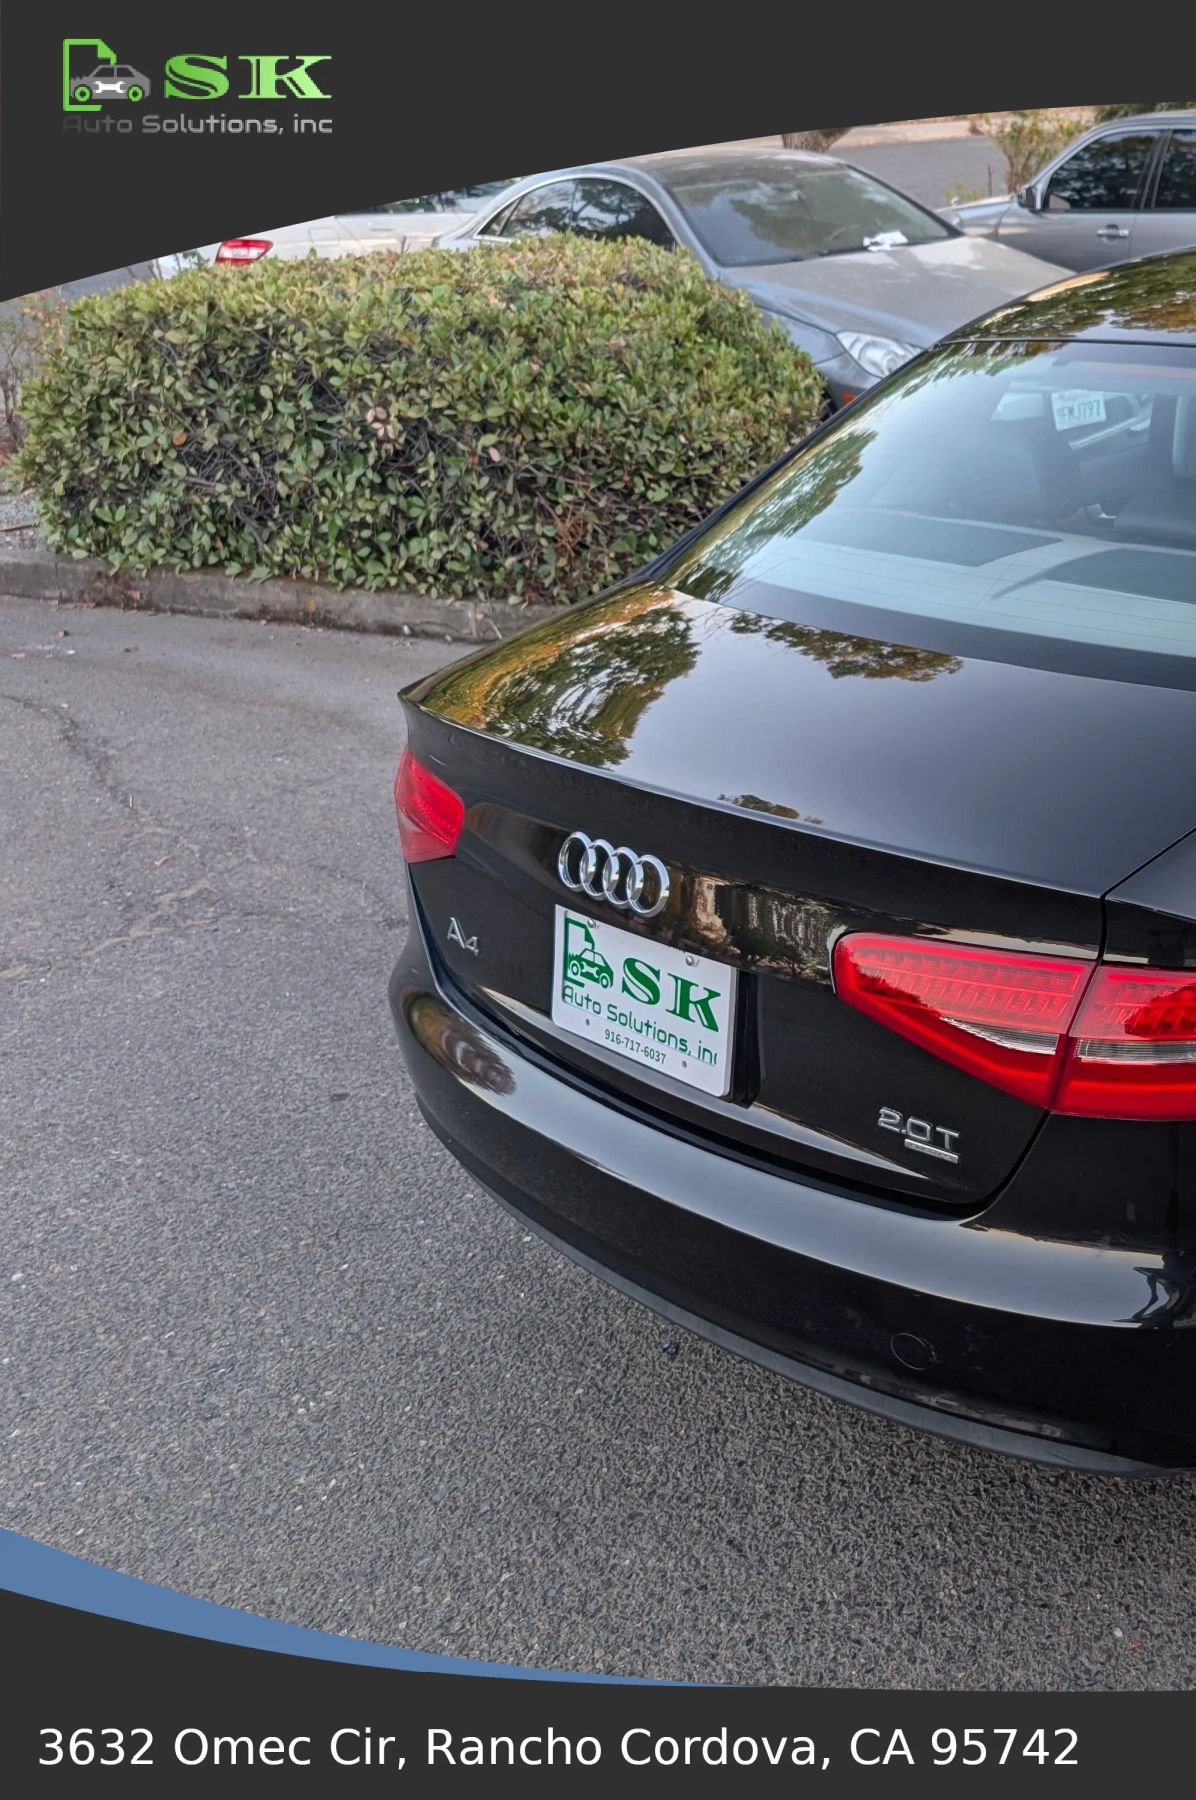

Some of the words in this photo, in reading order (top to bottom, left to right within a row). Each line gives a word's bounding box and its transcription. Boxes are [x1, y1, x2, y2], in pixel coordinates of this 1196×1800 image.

[446, 916, 479, 956] A4
[621, 957, 722, 1033] SK
[563, 985, 602, 1015] Auto
[606, 1003, 692, 1056] Solutions,
[603, 1028, 667, 1065] 916-717-6037
[877, 1106, 960, 1150] 2.0T
